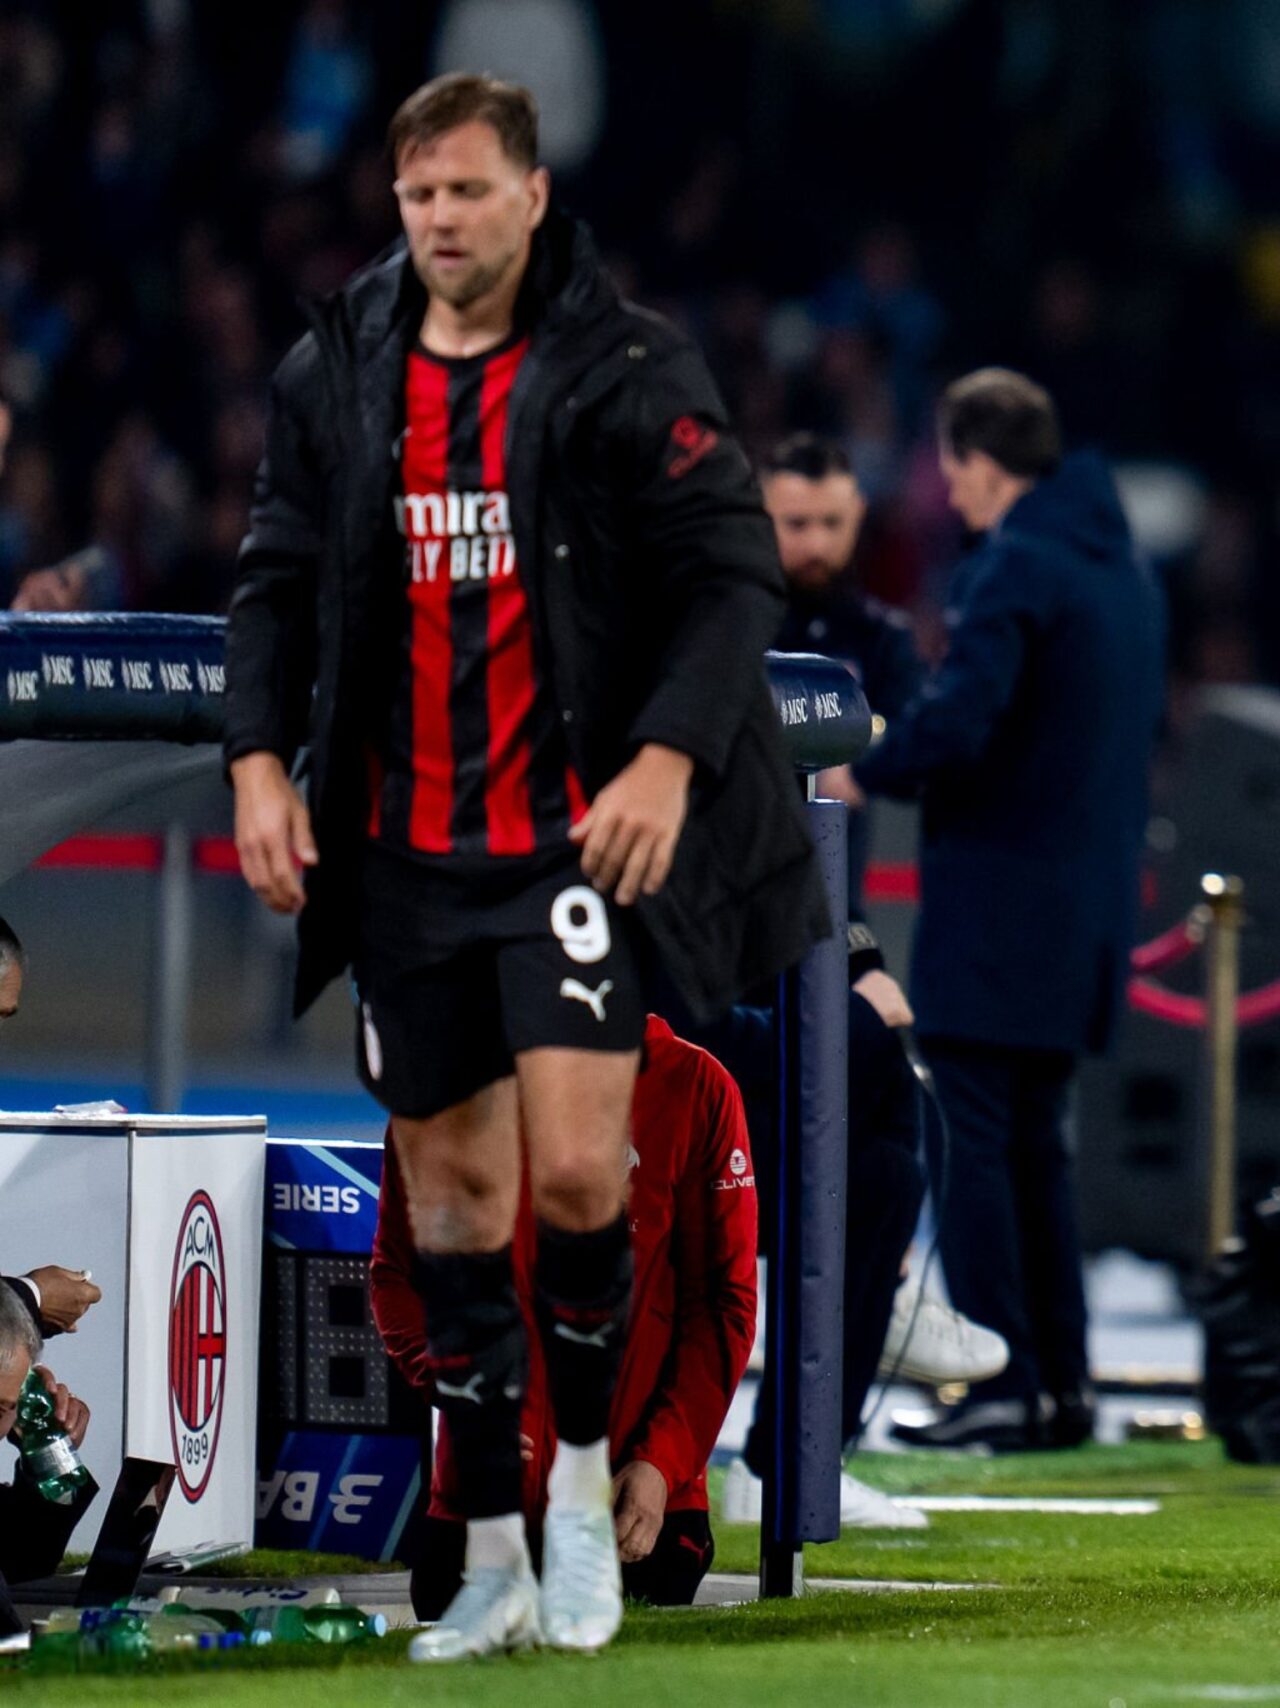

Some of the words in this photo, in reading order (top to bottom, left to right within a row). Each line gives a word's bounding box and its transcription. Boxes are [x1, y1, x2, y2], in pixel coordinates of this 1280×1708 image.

[786, 697, 808, 725] MSC
[820, 691, 842, 719] MSC
[551, 885, 611, 963] 9
[273, 1183, 361, 1215] SERIE
[711, 1176, 755, 1190] CLIVE
[182, 1215, 216, 1270] ACM
[181, 1433, 209, 1466] 1899
